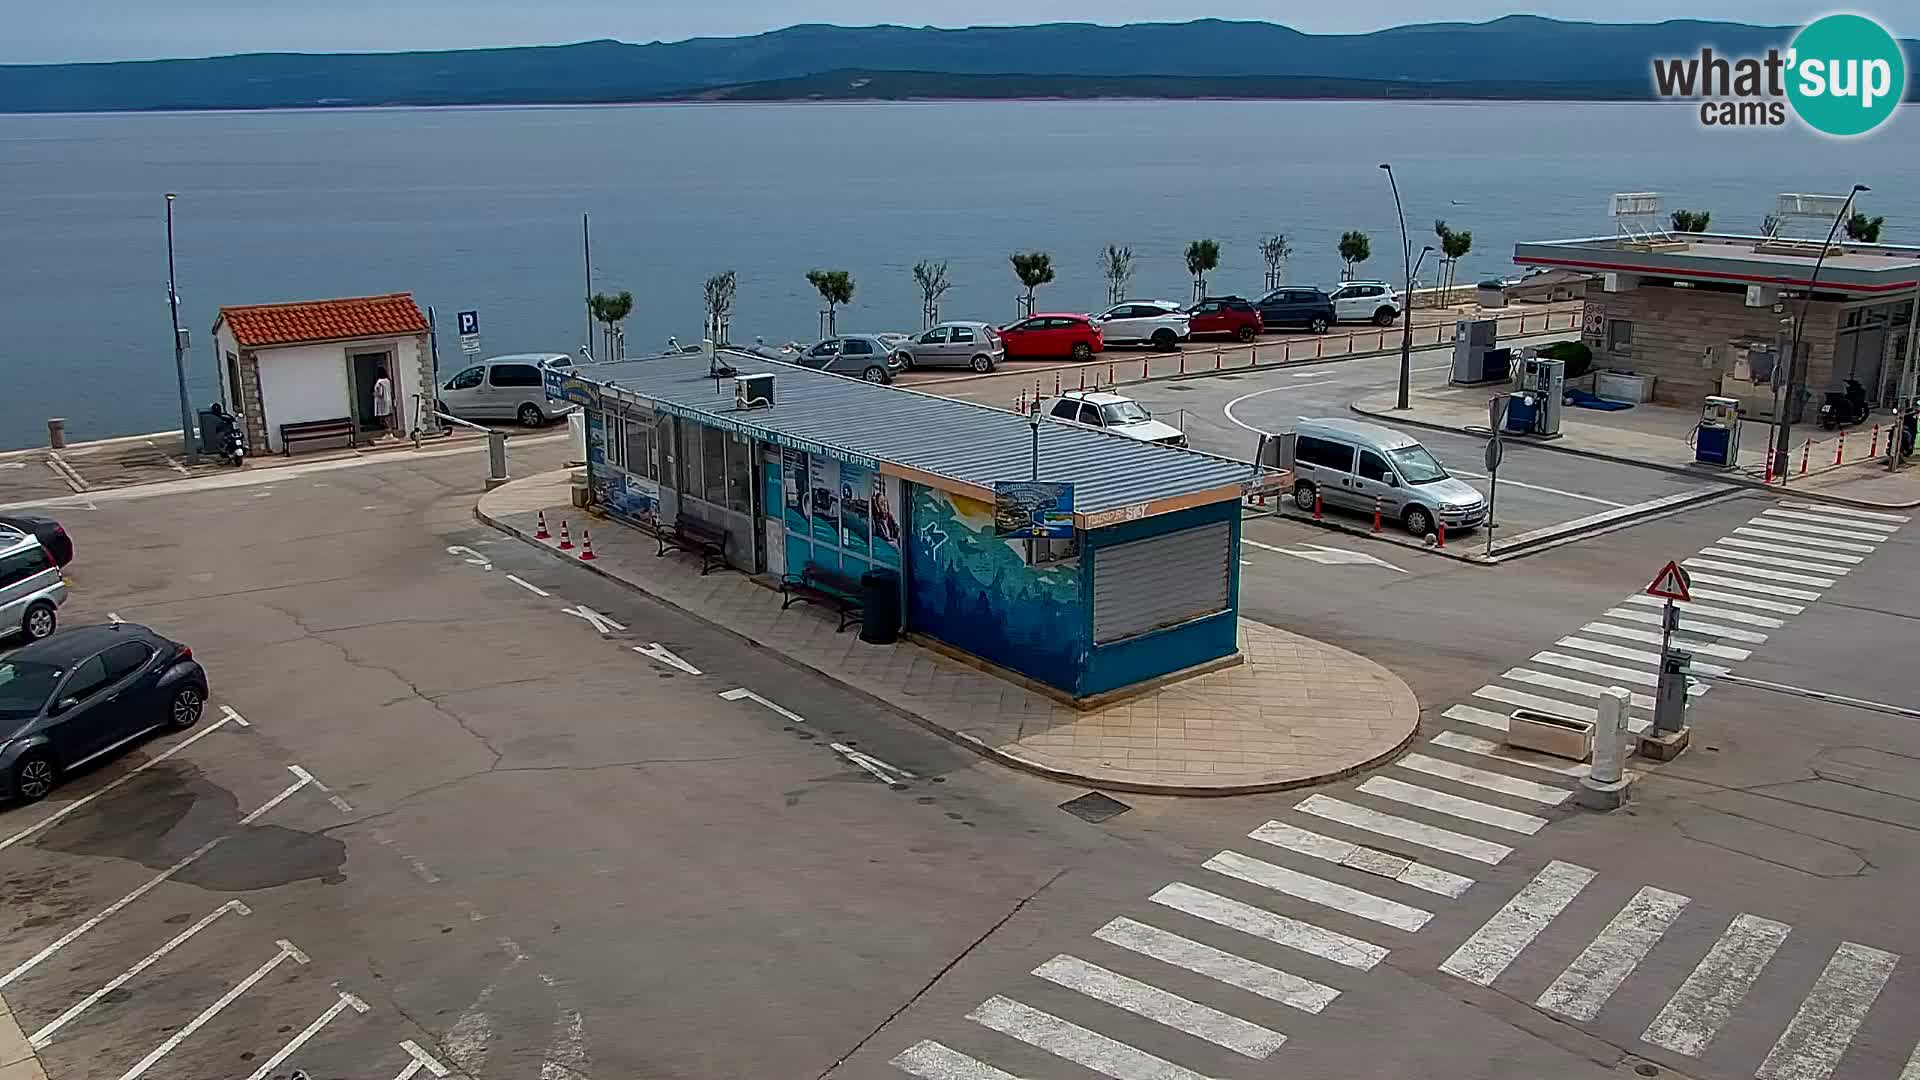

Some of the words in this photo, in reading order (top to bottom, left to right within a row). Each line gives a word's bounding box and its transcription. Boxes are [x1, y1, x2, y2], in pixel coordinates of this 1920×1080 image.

[462, 314, 474, 332] P
[738, 425, 768, 440] POSTAJA
[777, 434, 791, 447] BUS
[792, 438, 822, 455] STATION
[825, 447, 849, 462] TICKET
[850, 454, 876, 469] OFFICE
